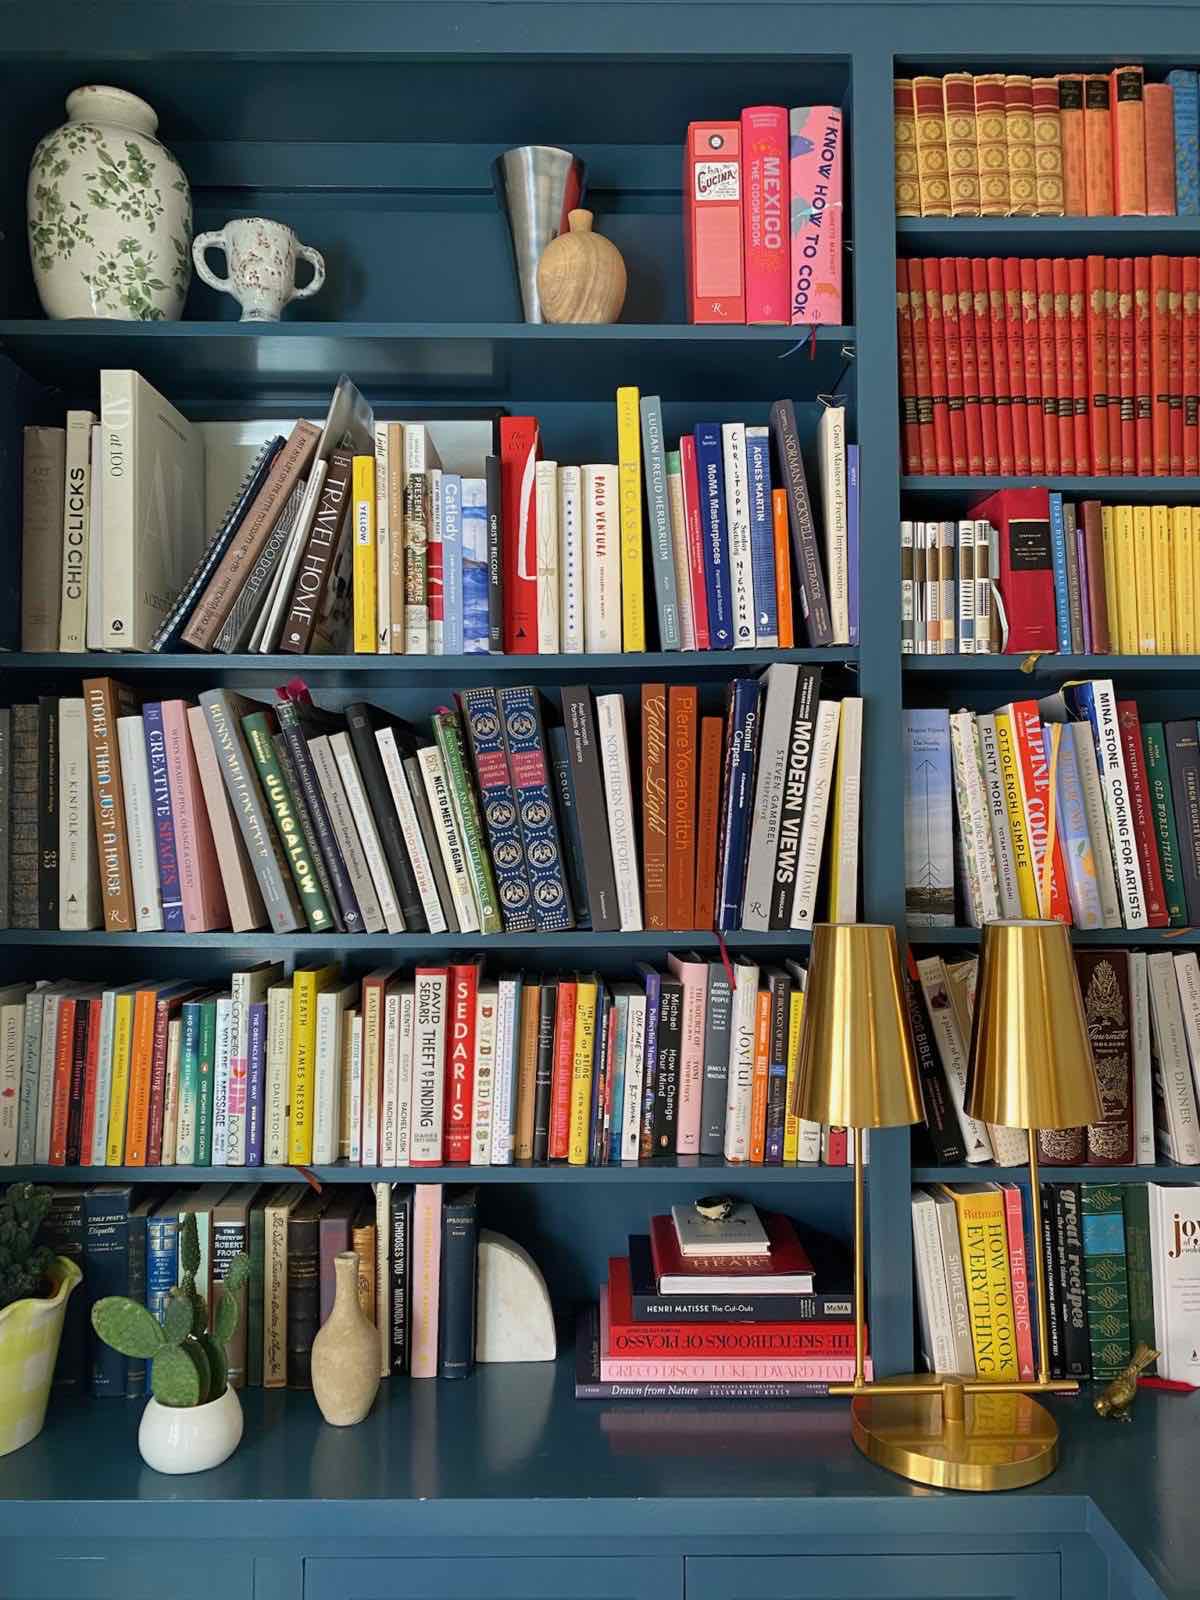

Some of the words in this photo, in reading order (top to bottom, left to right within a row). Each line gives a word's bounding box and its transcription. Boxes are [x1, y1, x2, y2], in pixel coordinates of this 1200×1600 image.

[752, 161, 760, 180] THE
[819, 127, 838, 179] KNOW
[752, 183, 760, 247] COOKBOOK
[764, 156, 782, 249] MEXICO
[809, 185, 828, 227] HOW
[804, 235, 819, 257] TO
[792, 265, 812, 316] COOK
[110, 434, 122, 447] at
[647, 412, 659, 453] LUCIAN
[832, 425, 842, 449] Great
[110, 450, 123, 477] 100
[651, 457, 662, 493] FREUD
[707, 464, 718, 497] MoMA
[753, 446, 762, 480] AGNES
[834, 453, 842, 492] Masters
[66, 467, 85, 546] CLICKS
[595, 476, 606, 506] PAOLO
[755, 483, 764, 522] MARTIN
[309, 477, 346, 549] TRAVEL
[359, 505, 367, 542] YELLOW
[444, 484, 457, 541] Catlady
[623, 463, 638, 560] PICASSO
[655, 496, 668, 561] HERBARIUM
[785, 435, 799, 483] NORMAN
[794, 486, 812, 544] ROCKWELL
[804, 546, 821, 600] ILLUSTRATOR
[835, 502, 843, 532] French
[595, 511, 606, 557] VENTURA
[709, 499, 721, 564] Masterpieces
[247, 529, 288, 593] WOODCUT
[835, 536, 844, 599] Impressionism
[290, 555, 320, 624] HOME
[90, 689, 107, 738] MORE
[675, 697, 693, 746] Pierre
[1099, 692, 1112, 725] MINA
[645, 695, 666, 764] Golden
[731, 730, 743, 767] Carpets
[744, 713, 755, 752] Oriental
[1104, 728, 1119, 769] STONE
[95, 742, 112, 784] THAN
[773, 749, 785, 790] STEVEN
[784, 720, 812, 810] MODERN
[1023, 711, 1049, 793] ALPINE
[1129, 743, 1139, 779] KITCHEN
[148, 730, 171, 817] CREATIVE
[208, 704, 231, 753] BUNNY
[225, 754, 254, 812] MELLON
[246, 815, 268, 857] STYLE
[434, 776, 445, 794] NICE
[983, 728, 997, 776] PLENTY
[991, 780, 1003, 816] MORE
[1134, 782, 1141, 791] IN
[68, 780, 78, 838] KINFOLK
[99, 789, 115, 829] JUST
[438, 797, 448, 807] TO
[605, 735, 620, 807] NORTHERN
[614, 810, 629, 874] COMFORT
[645, 766, 667, 836] Light
[674, 750, 691, 850] Yovanovitch
[998, 728, 1017, 815] OTTOLENGHI
[1012, 821, 1027, 868] SIMPLE
[1112, 779, 1128, 837] COOKING
[1136, 793, 1145, 826] FRANCE
[266, 773, 315, 894] JUNGALOW
[441, 808, 452, 828] MEET
[766, 795, 779, 845] GAMBREL
[102, 832, 117, 845] A
[445, 829, 457, 847] YOU
[776, 818, 801, 883] VIEWS
[1121, 839, 1133, 865] FOR
[42, 850, 56, 868] 33
[104, 848, 121, 896] HOUSE
[449, 848, 462, 874] AGAIN
[1125, 868, 1141, 919] ARTISTS
[299, 985, 308, 1026] BREATH
[403, 999, 411, 1037] COVENTRY
[418, 982, 430, 1025] SEDARIS
[432, 982, 442, 1024] DAVID
[661, 993, 670, 1022] Pollan
[669, 993, 679, 1031] Michael
[647, 1008, 657, 1045] Psilocybin
[297, 1043, 305, 1079] JAMES
[421, 1029, 436, 1068] THEFT
[452, 981, 469, 1121] SEDARIS
[646, 1046, 655, 1087] Mushrooms
[659, 1048, 668, 1071] Your
[668, 1049, 677, 1071] How
[735, 1025, 754, 1087] Joyful
[915, 1033, 932, 1070] BIBLE
[272, 1083, 280, 1108] DAILY
[645, 1088, 653, 1096] of
[658, 1072, 666, 1097] Mind
[667, 1073, 675, 1083] to
[215, 1080, 227, 1127] MESSAGE
[295, 1084, 304, 1127] NESTOR
[400, 1102, 408, 1131] RACHEL
[420, 1079, 435, 1127] FINDING
[645, 1097, 653, 1111] the
[665, 1085, 675, 1121] Change
[1173, 1071, 1191, 1126] DINNER
[228, 1115, 239, 1153] BOOK
[271, 1112, 280, 1140] STOIC
[385, 1131, 393, 1152] CUSK
[644, 1112, 652, 1134] World
[395, 1212, 404, 1221] IT
[1059, 1189, 1079, 1247] great
[394, 1221, 404, 1257] CHOOSES
[987, 1223, 1006, 1271] HOW
[394, 1258, 403, 1274] YOU
[948, 1254, 964, 1301] SIMPLE
[1011, 1247, 1023, 1276] THE
[394, 1288, 403, 1324] MIRANDA
[647, 1304, 673, 1313] HENRI
[675, 1304, 710, 1313] MATISSE
[711, 1304, 723, 1312] The
[724, 1305, 754, 1313] Cut-Outs
[826, 1303, 849, 1312] MoMA
[966, 1224, 995, 1372] EVERYTHING
[994, 1277, 1009, 1306] TO
[1014, 1280, 1029, 1331] PICNIC
[1066, 1253, 1085, 1328] recipes
[393, 1326, 403, 1345] JULY
[954, 1304, 968, 1337] CAKE
[615, 1335, 680, 1348] PICASSO
[682, 1335, 705, 1348] OF
[708, 1334, 824, 1348] SKETCHBOOKS
[997, 1313, 1015, 1371] COOK
[611, 1385, 648, 1396] Drawn
[649, 1385, 666, 1395] from
[668, 1385, 699, 1396] Nature
